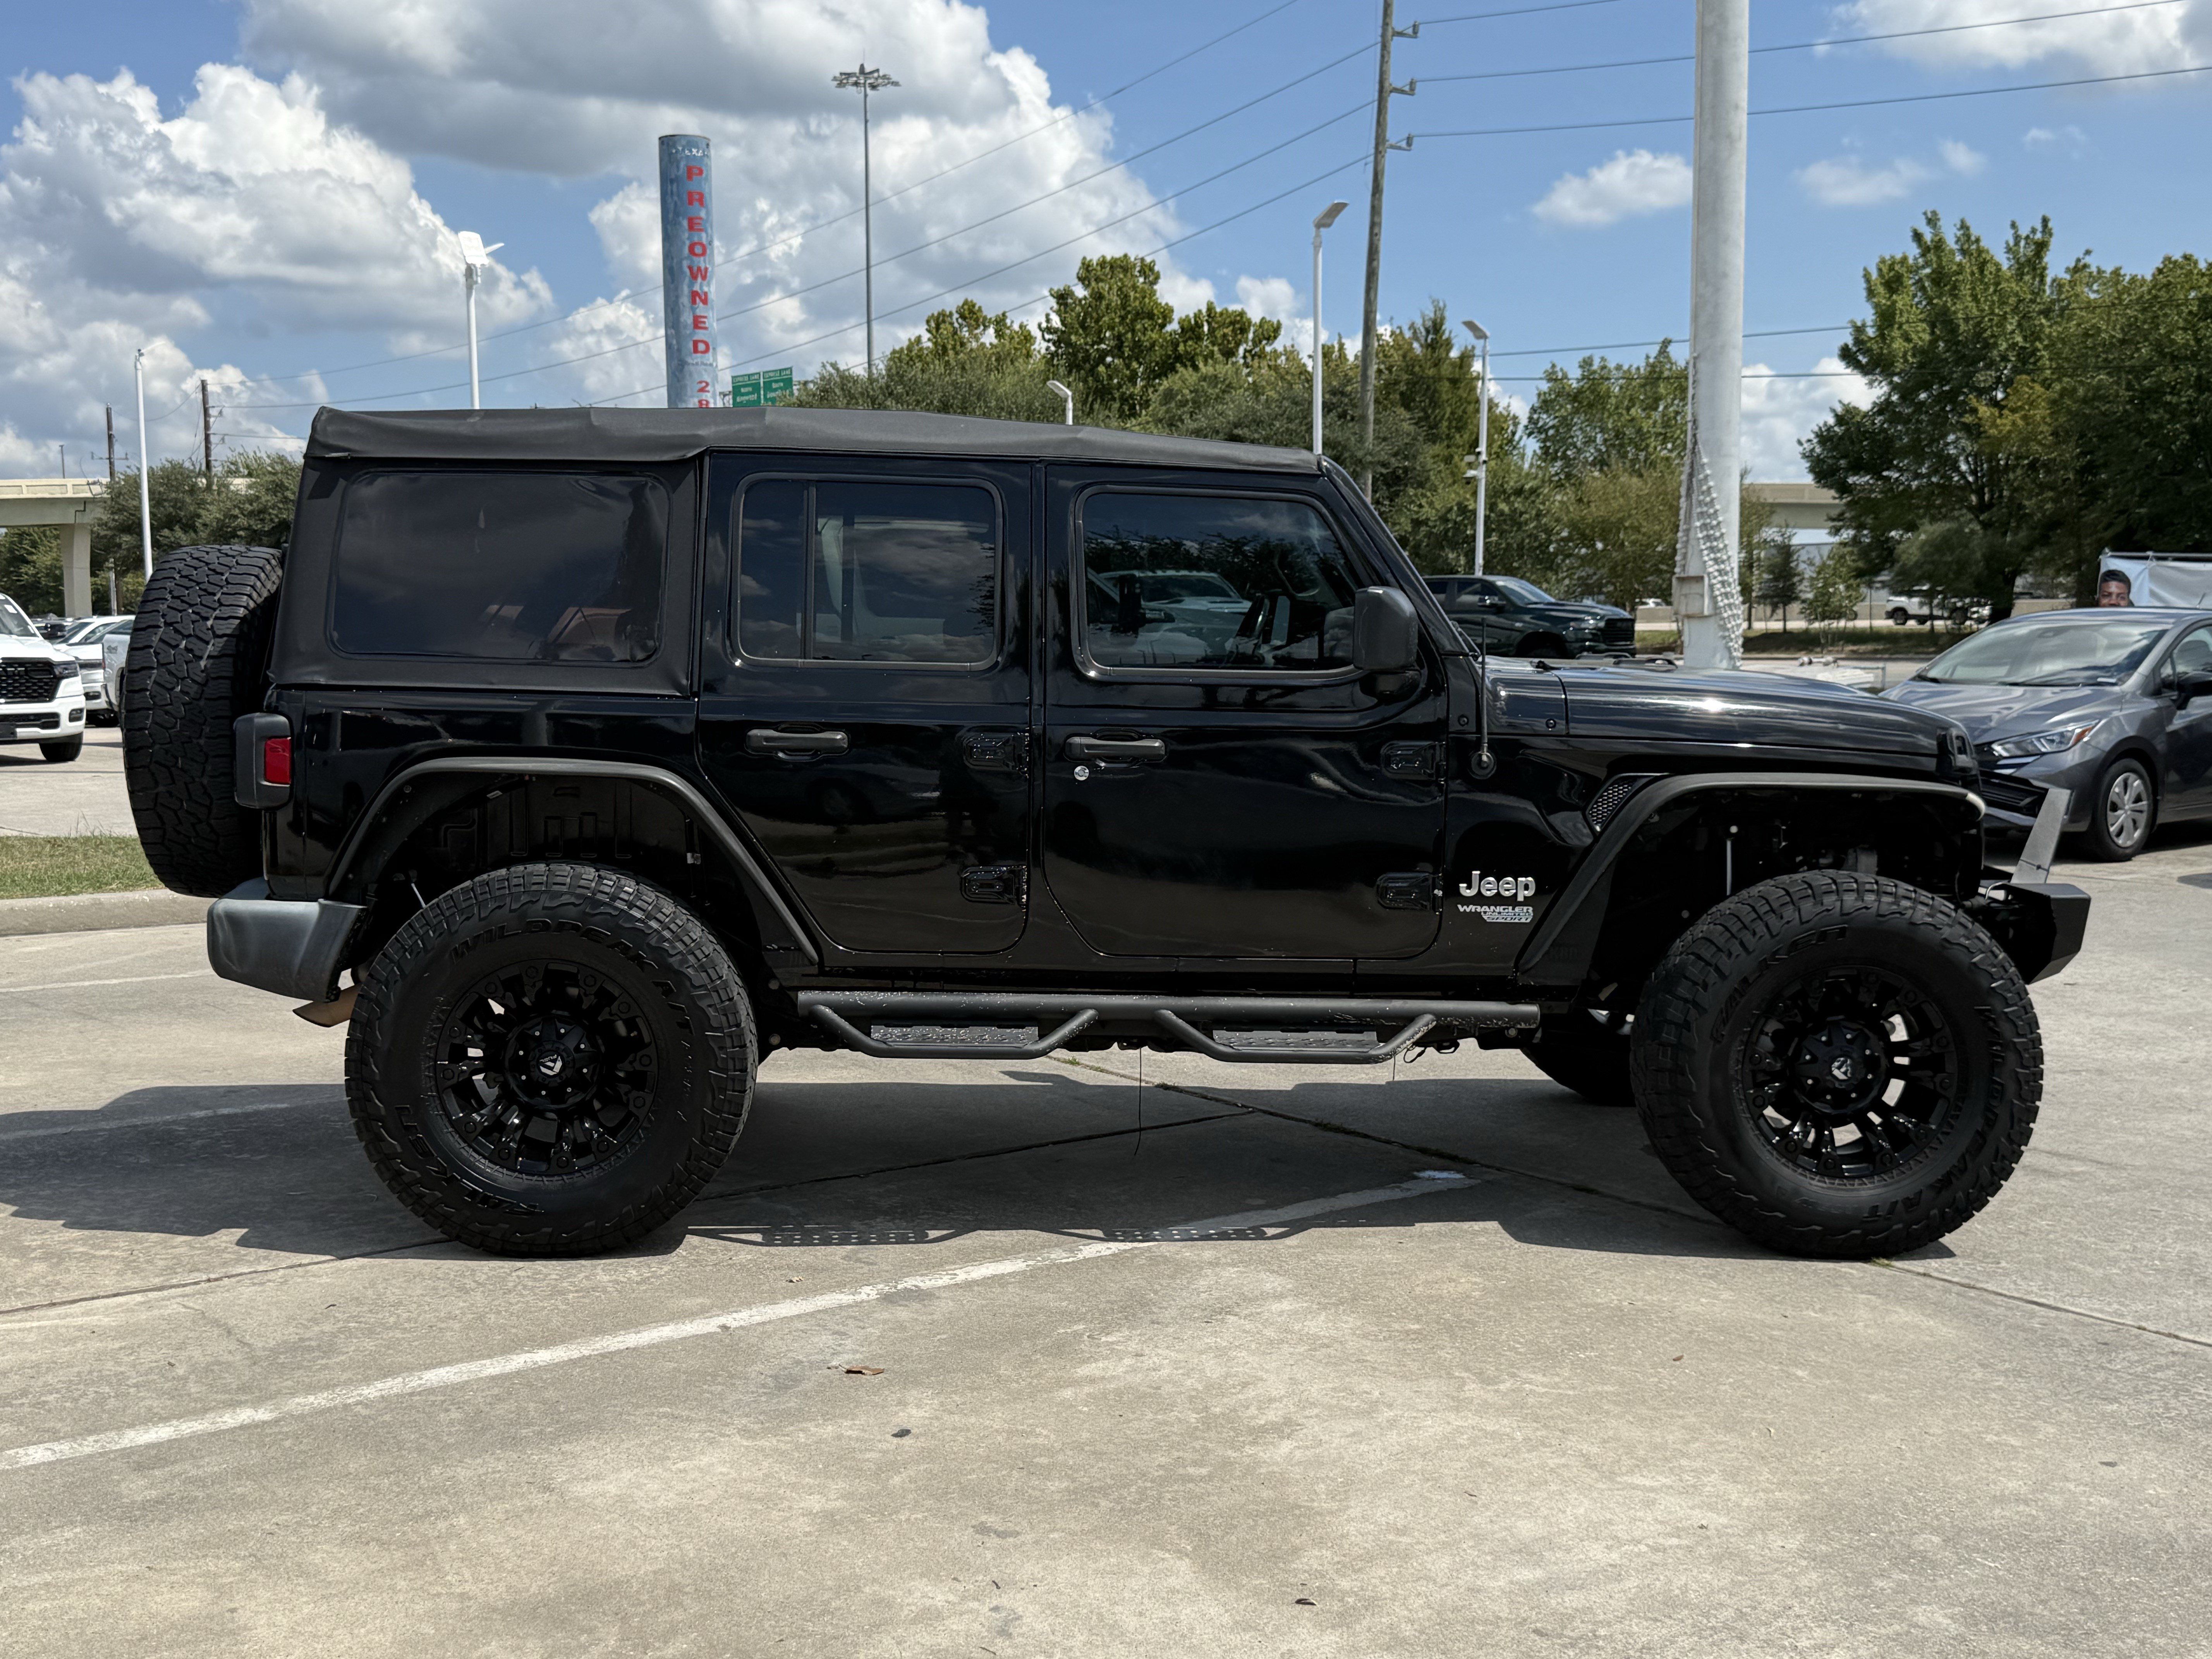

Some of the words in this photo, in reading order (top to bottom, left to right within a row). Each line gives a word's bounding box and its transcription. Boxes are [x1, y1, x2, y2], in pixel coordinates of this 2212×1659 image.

[686, 165, 711, 354] PREOWNED
[1459, 871, 1535, 902] Jeep
[451, 918, 659, 972] WILDPEAK
[394, 1105, 544, 1218] FALKEN
